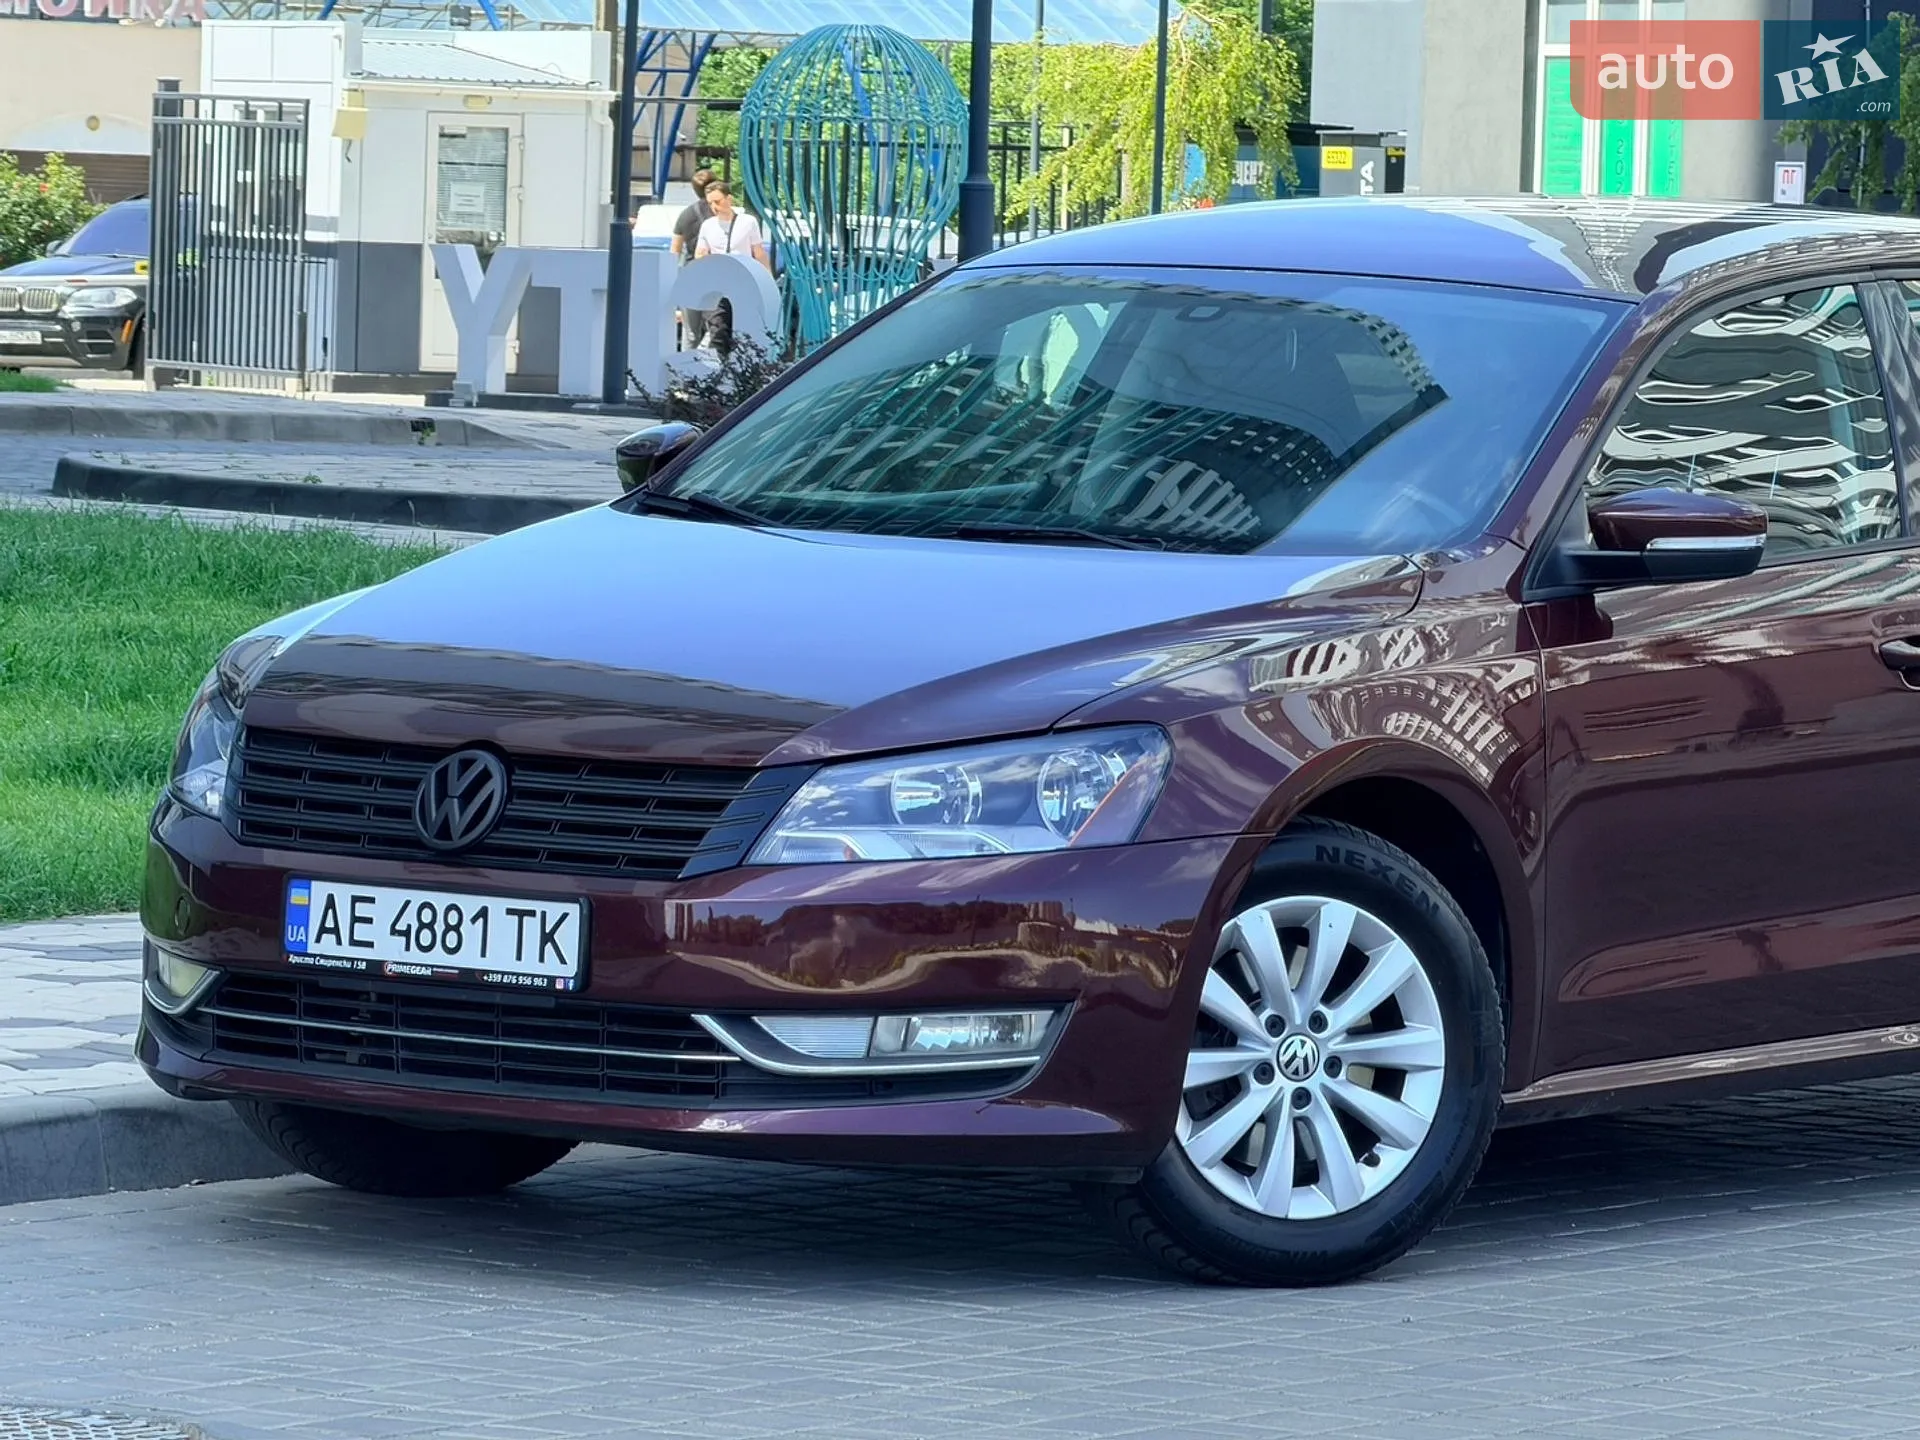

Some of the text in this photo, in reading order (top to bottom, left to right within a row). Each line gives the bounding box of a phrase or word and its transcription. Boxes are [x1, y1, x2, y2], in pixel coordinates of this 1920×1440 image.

[287, 923, 306, 943] UA
[314, 892, 569, 966] AE 4881 TK
